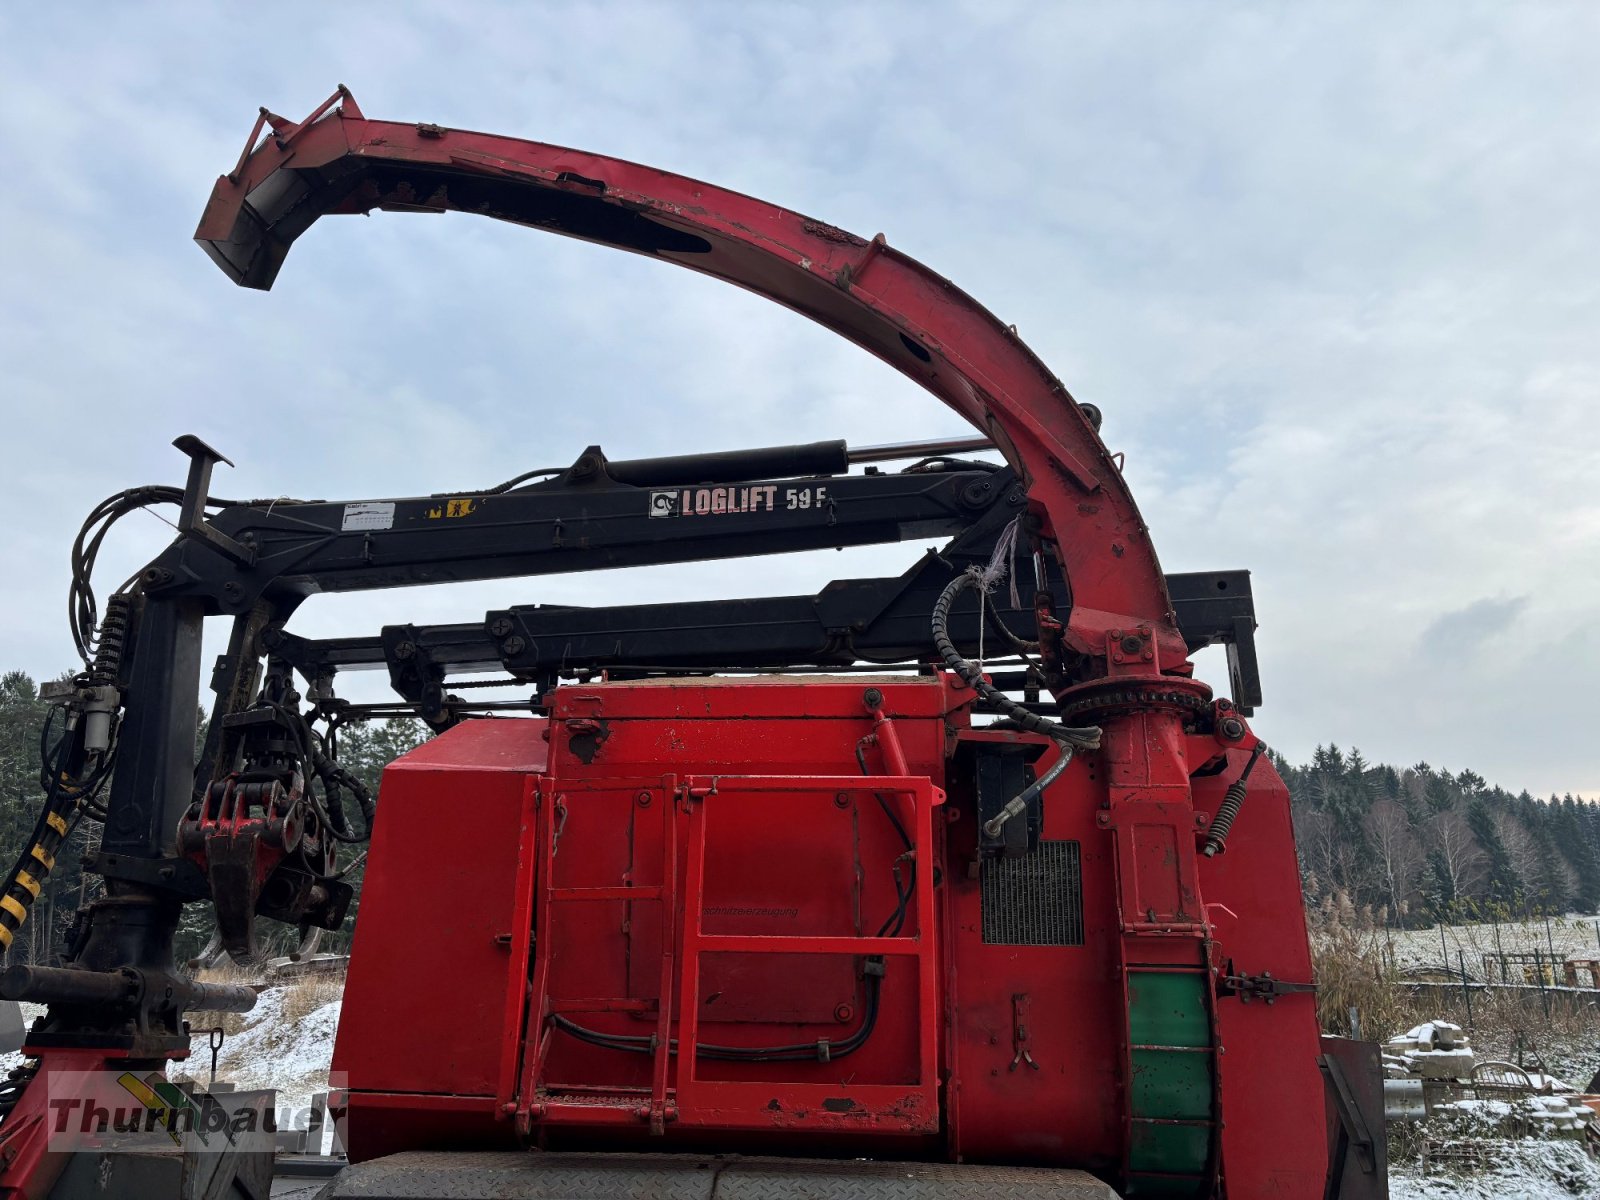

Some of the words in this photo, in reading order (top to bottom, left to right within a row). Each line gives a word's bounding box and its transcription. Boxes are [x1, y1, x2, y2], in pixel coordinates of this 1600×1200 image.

[682, 486, 777, 516] LOGLIFT
[786, 488, 811, 510] 59
[816, 487, 826, 508] F
